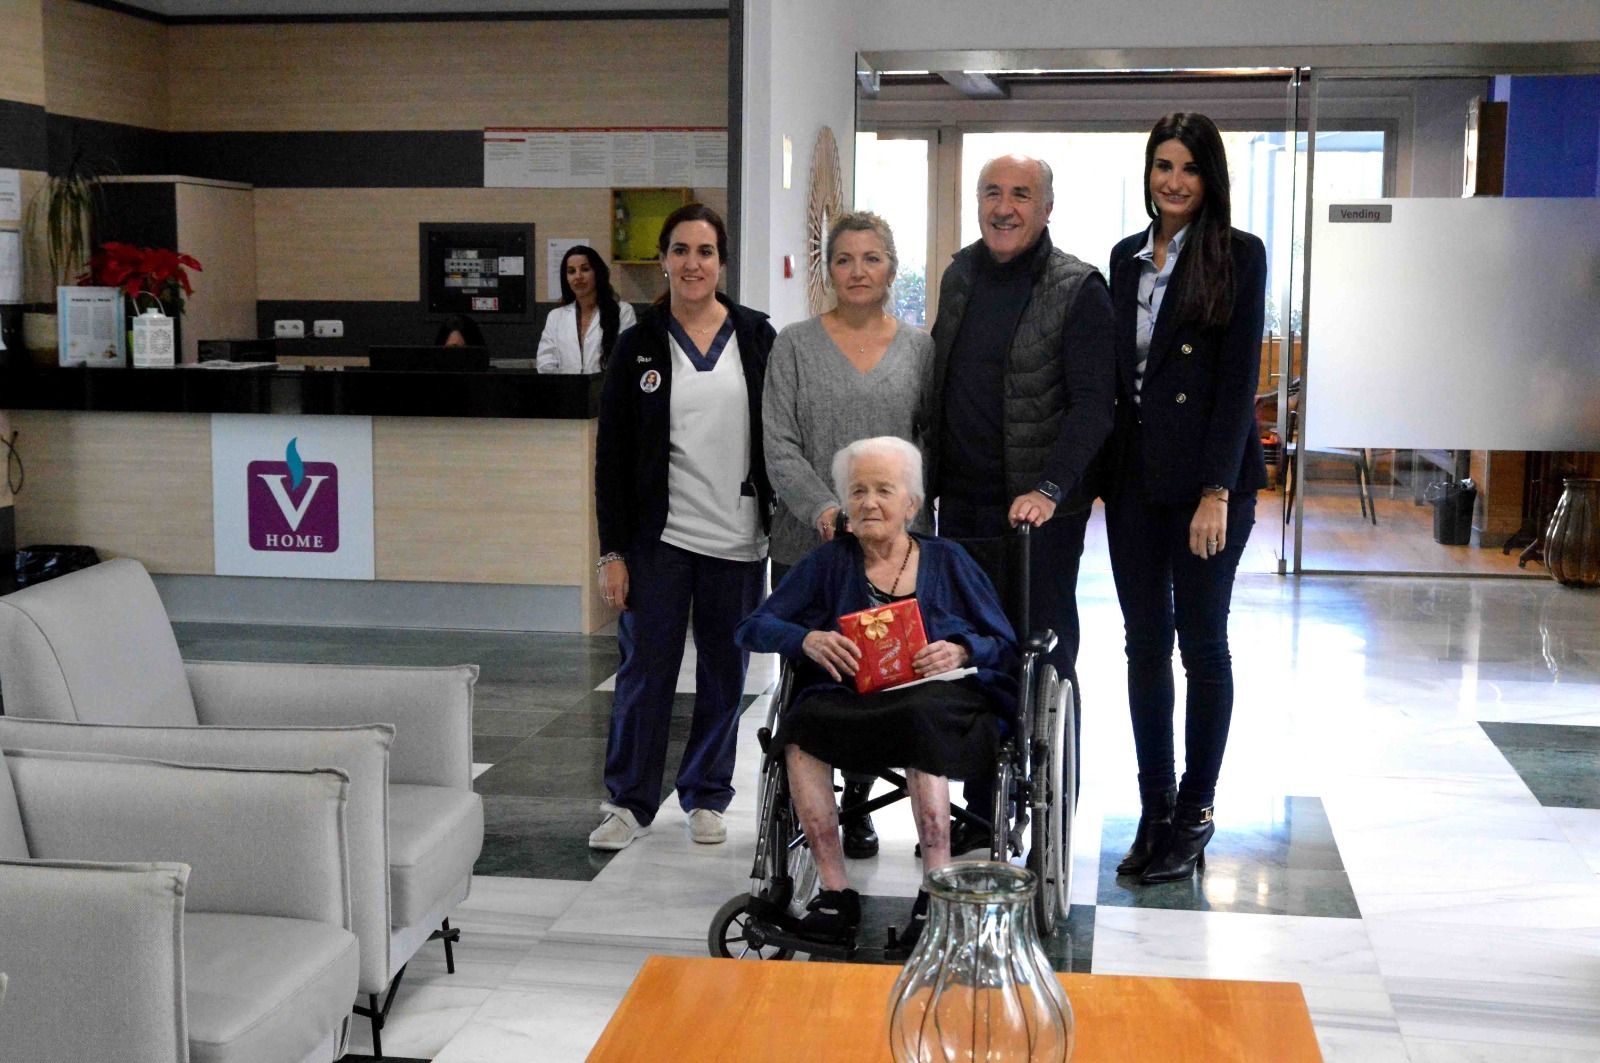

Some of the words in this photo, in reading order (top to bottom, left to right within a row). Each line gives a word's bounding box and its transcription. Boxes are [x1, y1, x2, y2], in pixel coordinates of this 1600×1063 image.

[1340, 208, 1381, 221] Vending
[257, 474, 329, 532] V
[266, 534, 323, 548] HOME
